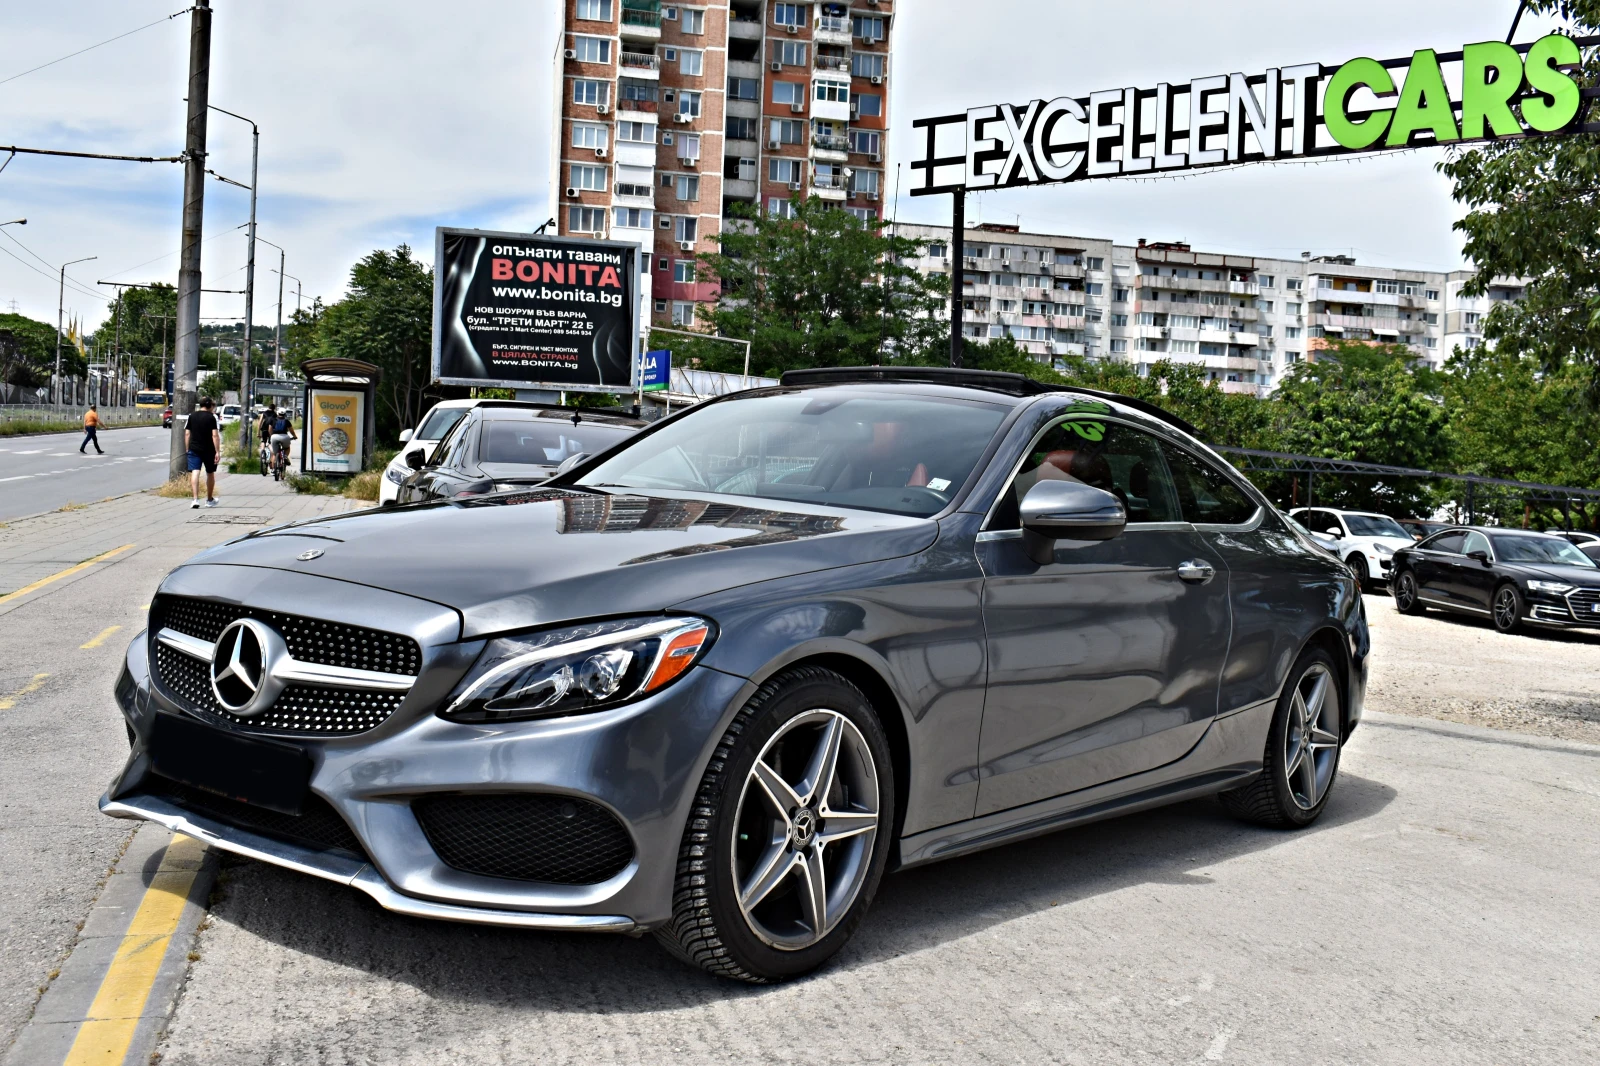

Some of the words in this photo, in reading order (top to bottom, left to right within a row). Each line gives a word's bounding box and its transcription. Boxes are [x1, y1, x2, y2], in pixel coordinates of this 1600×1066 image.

[964, 61, 1325, 188] EXCELLENT
[1323, 33, 1582, 150] CARS
[492, 245, 562, 259] опънати
[566, 250, 621, 264] тавани
[491, 258, 621, 288] BONITA
[492, 286, 622, 307] www.bonita.bg
[474, 306, 494, 314] НОВ
[496, 308, 534, 316] ШОУРУМ
[536, 309, 555, 317] ВЪВ
[557, 310, 587, 319] ВАРНА
[466, 315, 489, 325] бул.
[571, 321, 584, 329] 22
[586, 321, 594, 330] Б
[492, 350, 499, 358] В
[501, 351, 538, 359] ЦЯЛАТА
[540, 353, 578, 361] СТРАНА!
[492, 360, 578, 370] www.BONITA.bg
[320, 401, 346, 410] Glovo
